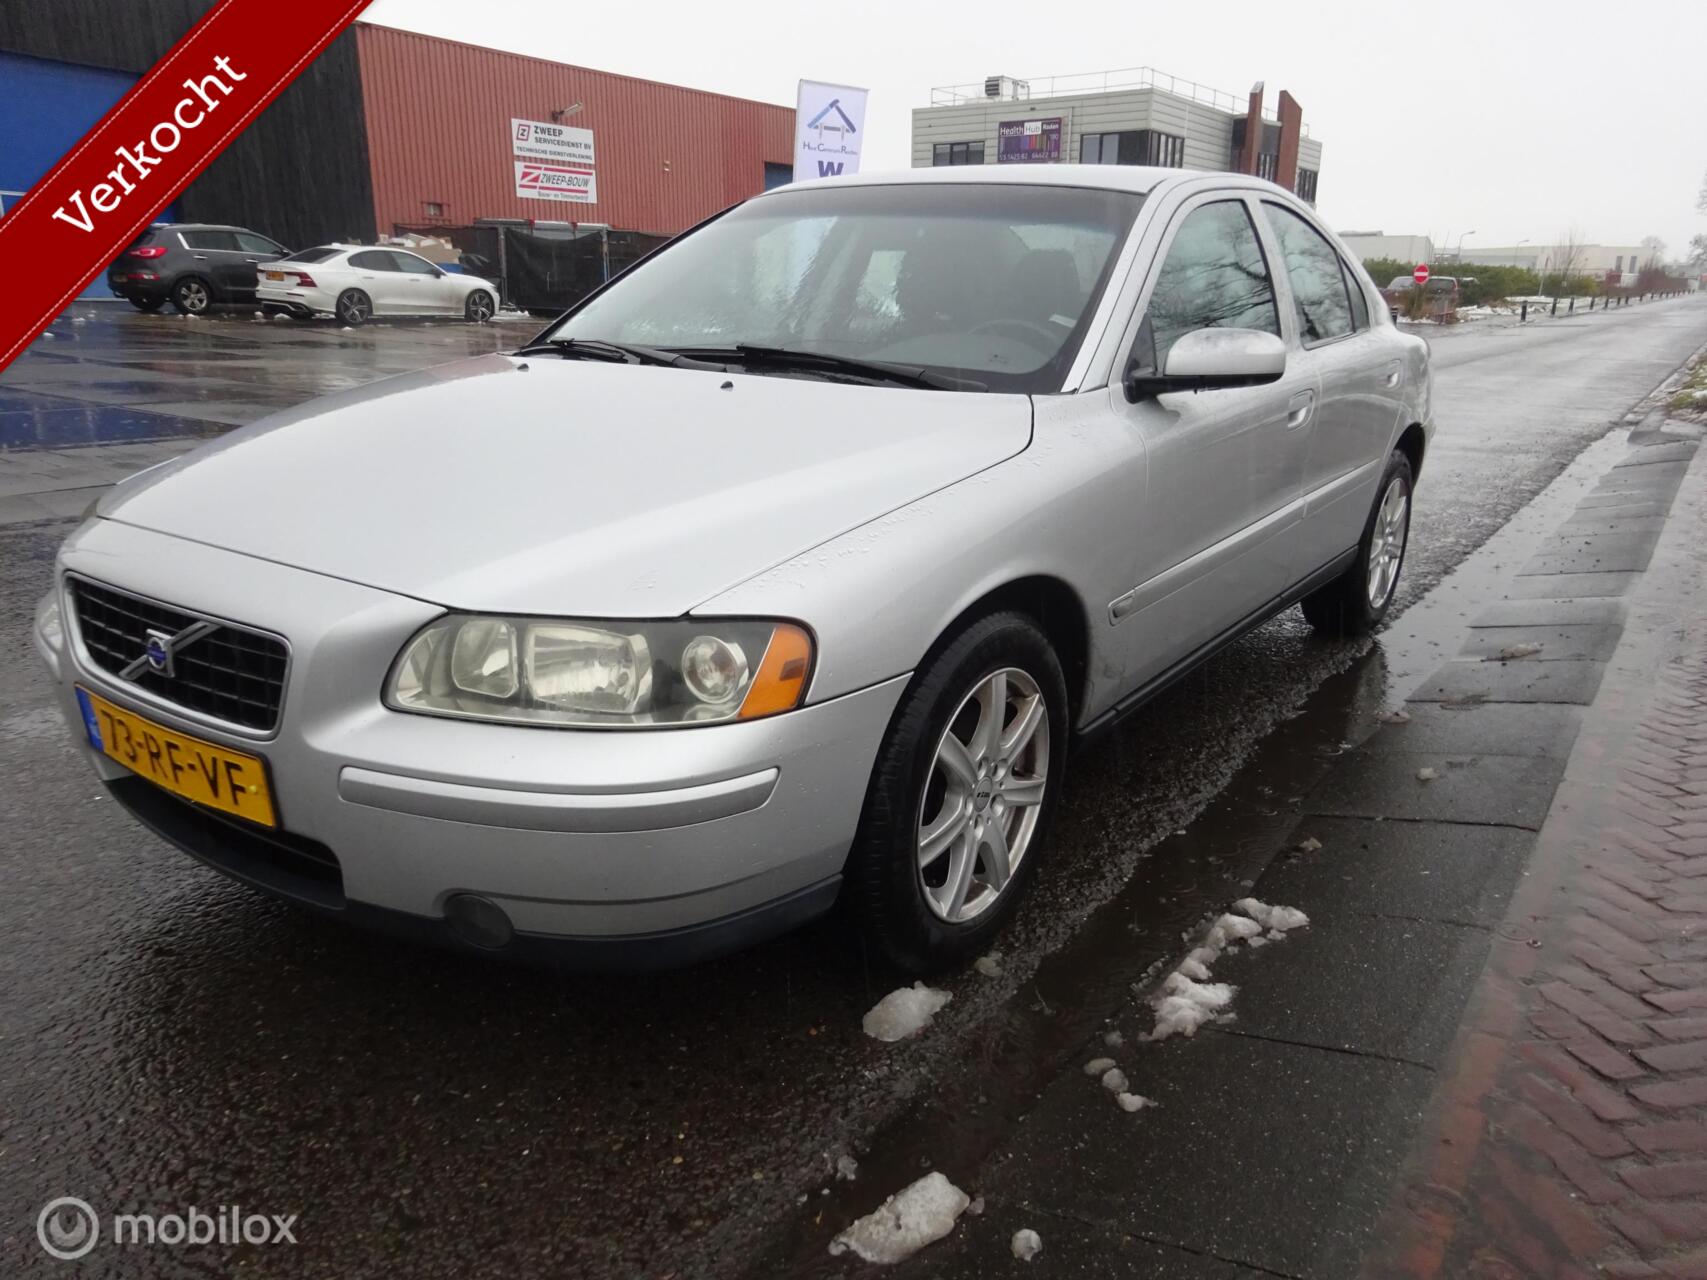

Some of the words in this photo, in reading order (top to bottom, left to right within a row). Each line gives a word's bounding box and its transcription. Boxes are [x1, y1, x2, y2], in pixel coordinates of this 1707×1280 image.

[534, 125, 563, 137] ZWEEP
[535, 137, 582, 149] SERVICEDIENST
[541, 174, 590, 187] ZWEEP-BOUW
[101, 710, 247, 806] 73-RF-VF
